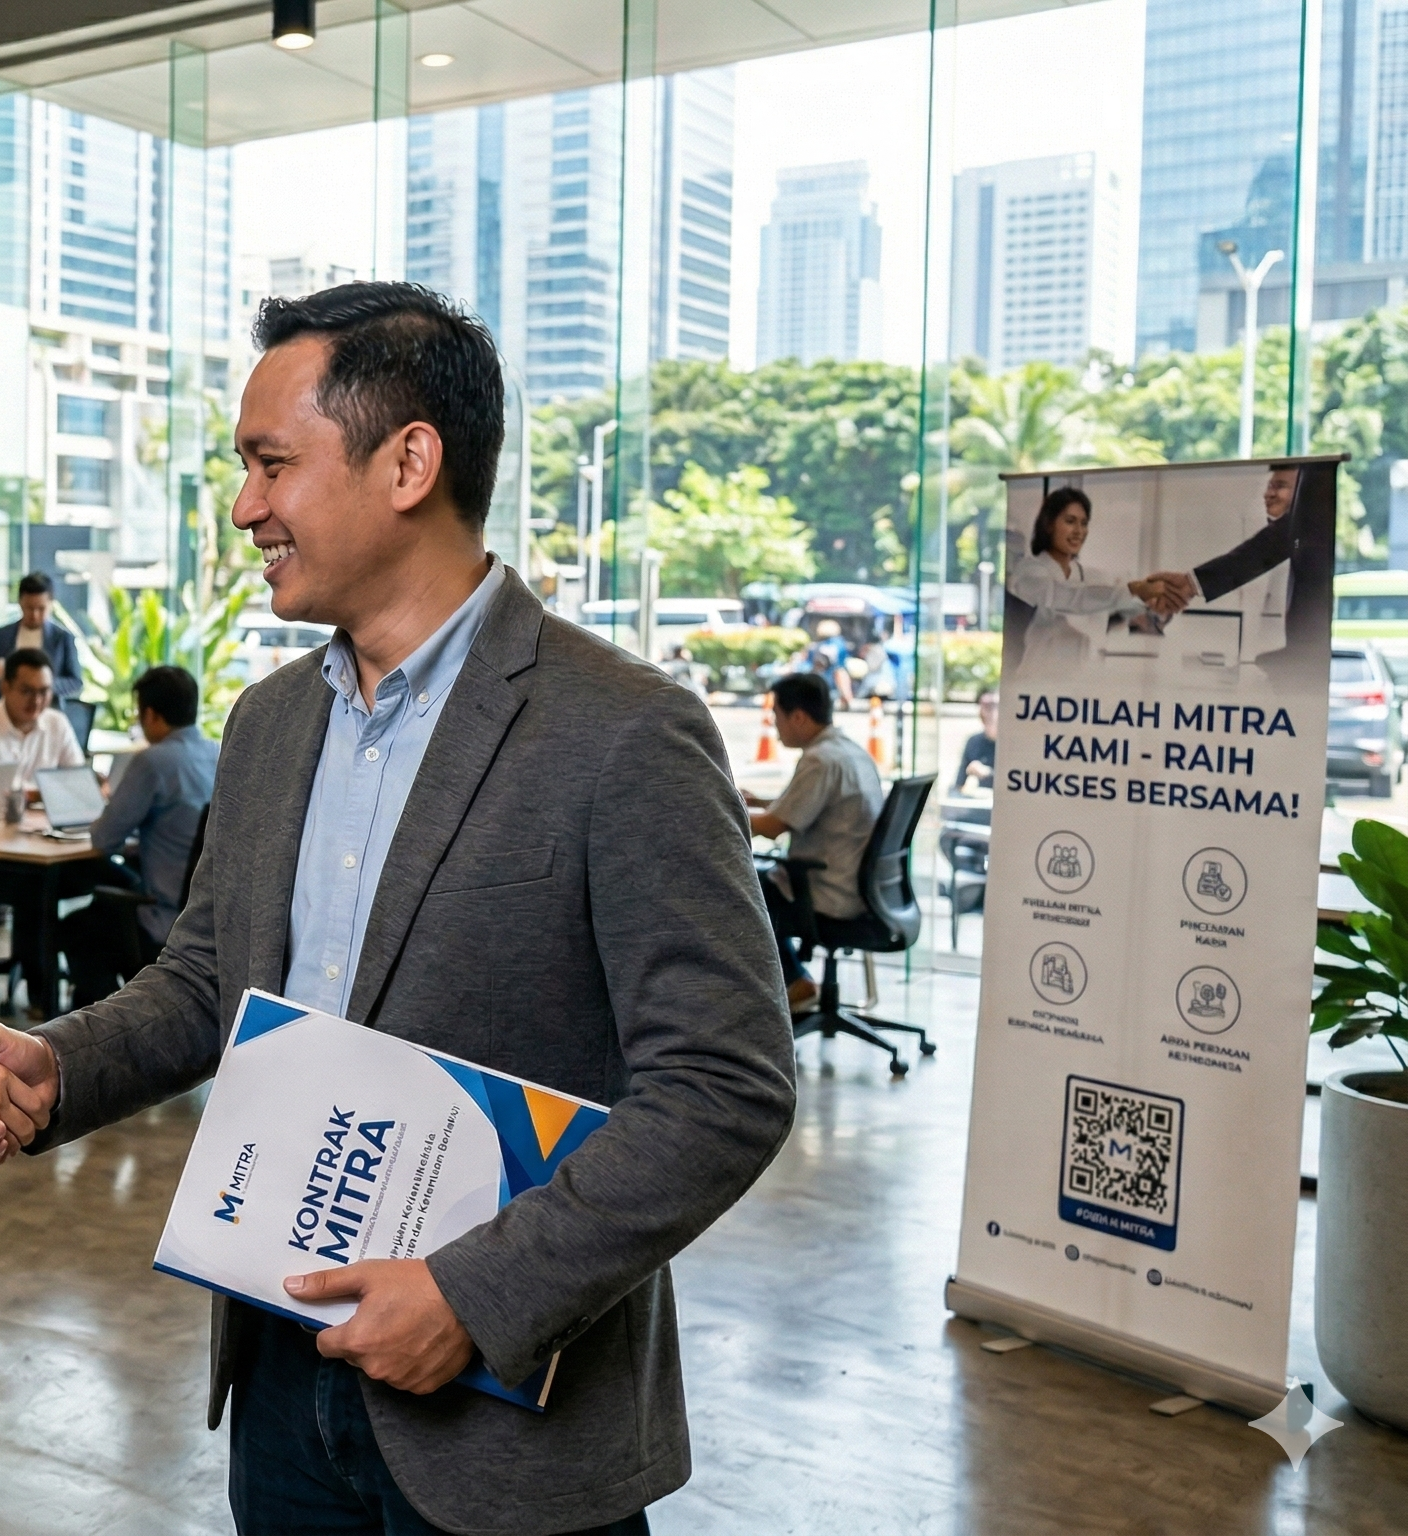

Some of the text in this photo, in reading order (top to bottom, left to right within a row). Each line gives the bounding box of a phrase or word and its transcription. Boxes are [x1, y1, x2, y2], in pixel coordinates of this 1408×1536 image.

[1015, 694, 1297, 738] JADILAH MITRA
[1043, 734, 1130, 766] KAMI
[1164, 742, 1254, 776] RAIH
[1007, 769, 1300, 819] SUKSES BERSAMA!
[229, 1142, 256, 1191] MITRA
[1109, 1138, 1132, 1162] M
[288, 1104, 356, 1252] KONTRAK
[315, 1120, 396, 1265] MITRA
